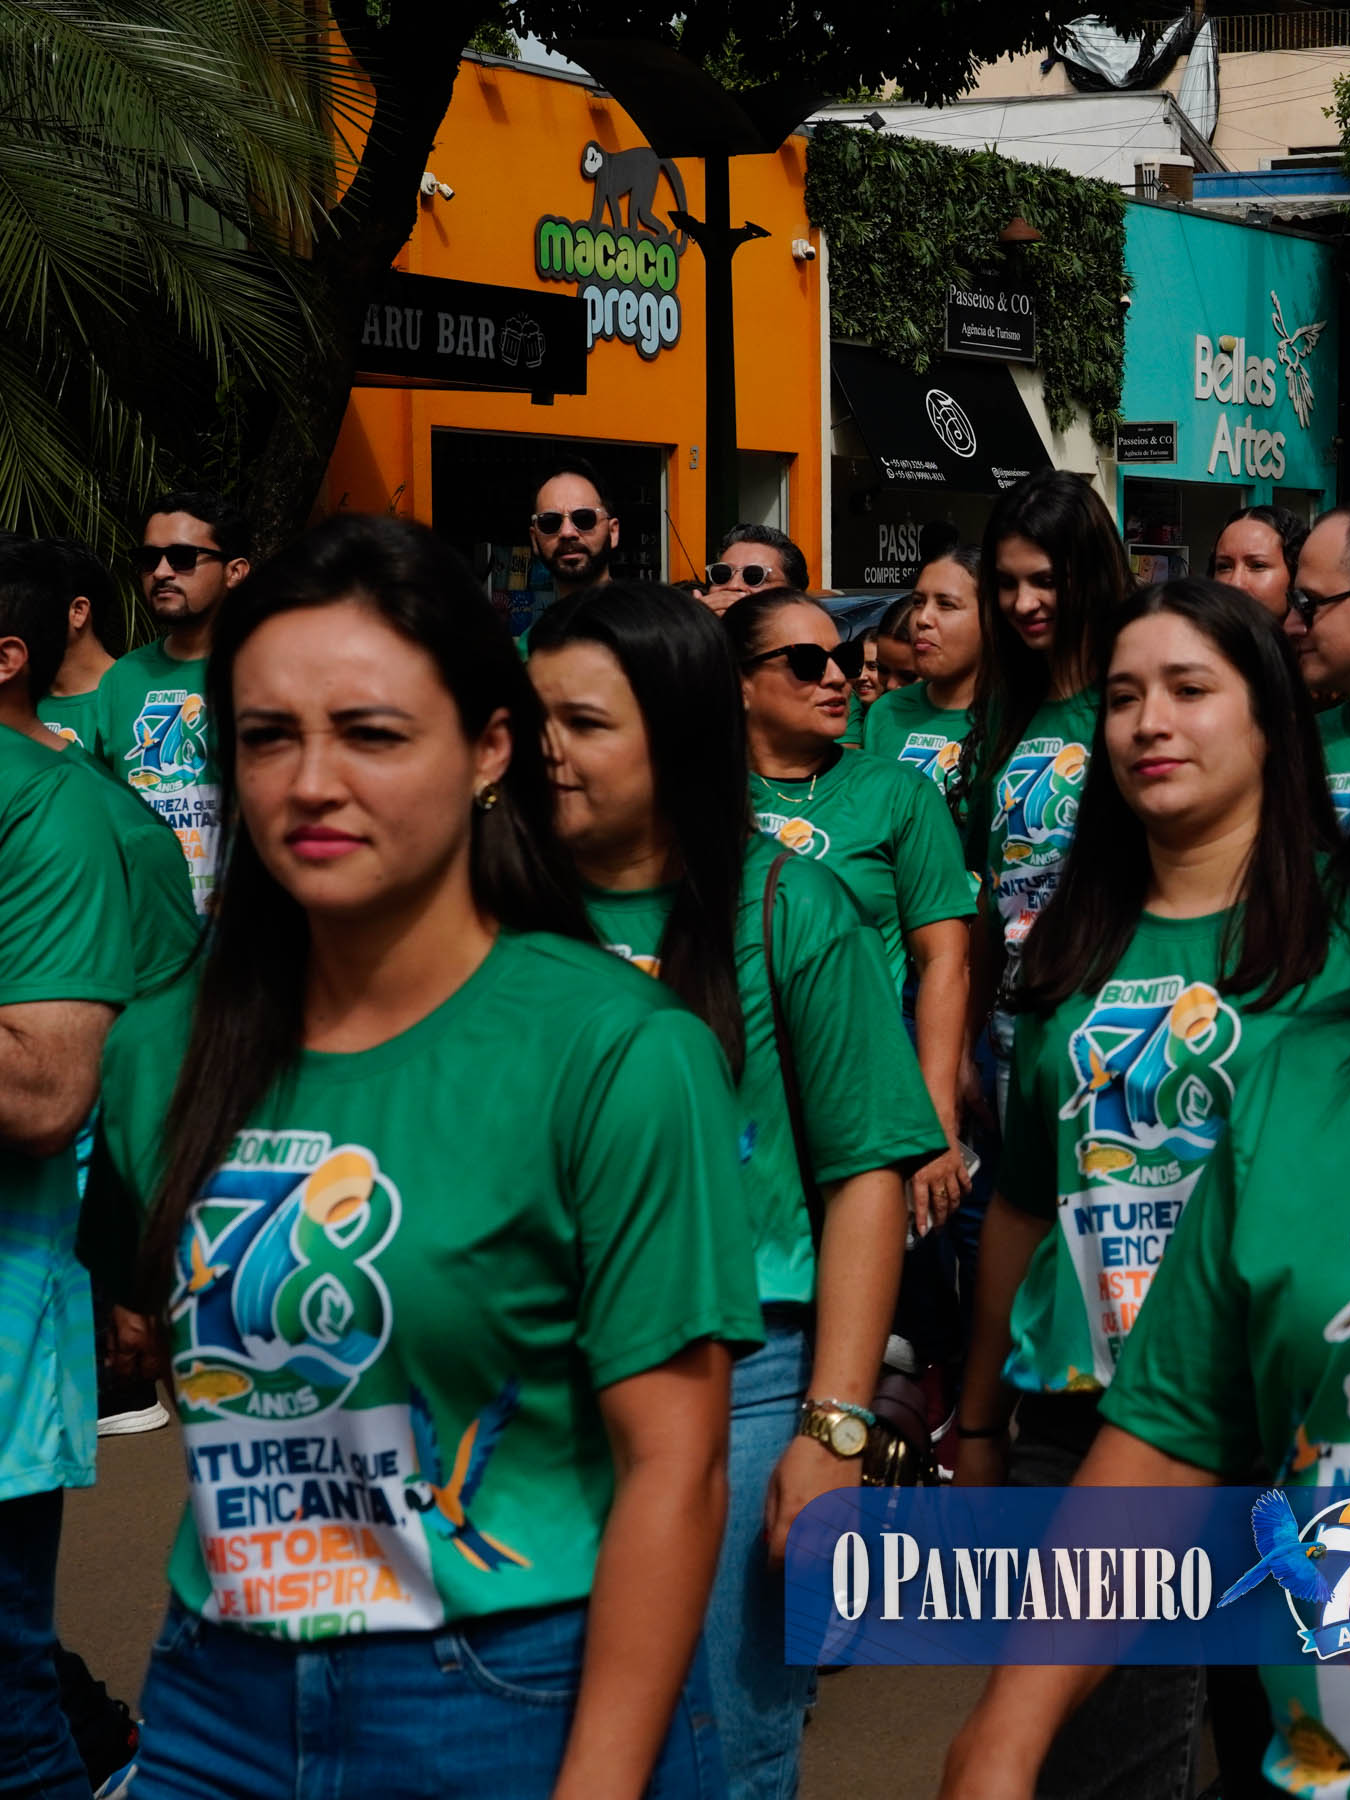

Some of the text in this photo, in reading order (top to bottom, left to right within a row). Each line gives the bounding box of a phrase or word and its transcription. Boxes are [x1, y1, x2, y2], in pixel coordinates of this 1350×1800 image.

[539, 221, 677, 291] macaco
[949, 284, 1032, 315] Passeios & CO.
[361, 303, 496, 359] ARU BAR
[587, 285, 679, 353] prego
[962, 322, 1020, 340] Agência de Turismo
[1118, 436, 1148, 446] Passeios
[1150, 436, 1157, 444] &
[1208, 412, 1285, 480] Artes
[865, 567, 900, 583] COMPRE
[147, 691, 187, 704] BONITO
[908, 735, 945, 749] BONITO
[156, 780, 184, 792] ANOS
[1030, 848, 1061, 865] ANOS
[1102, 980, 1179, 1004] BONITO
[1129, 1160, 1182, 1185] ANOS
[247, 1386, 319, 1418] ANOS
